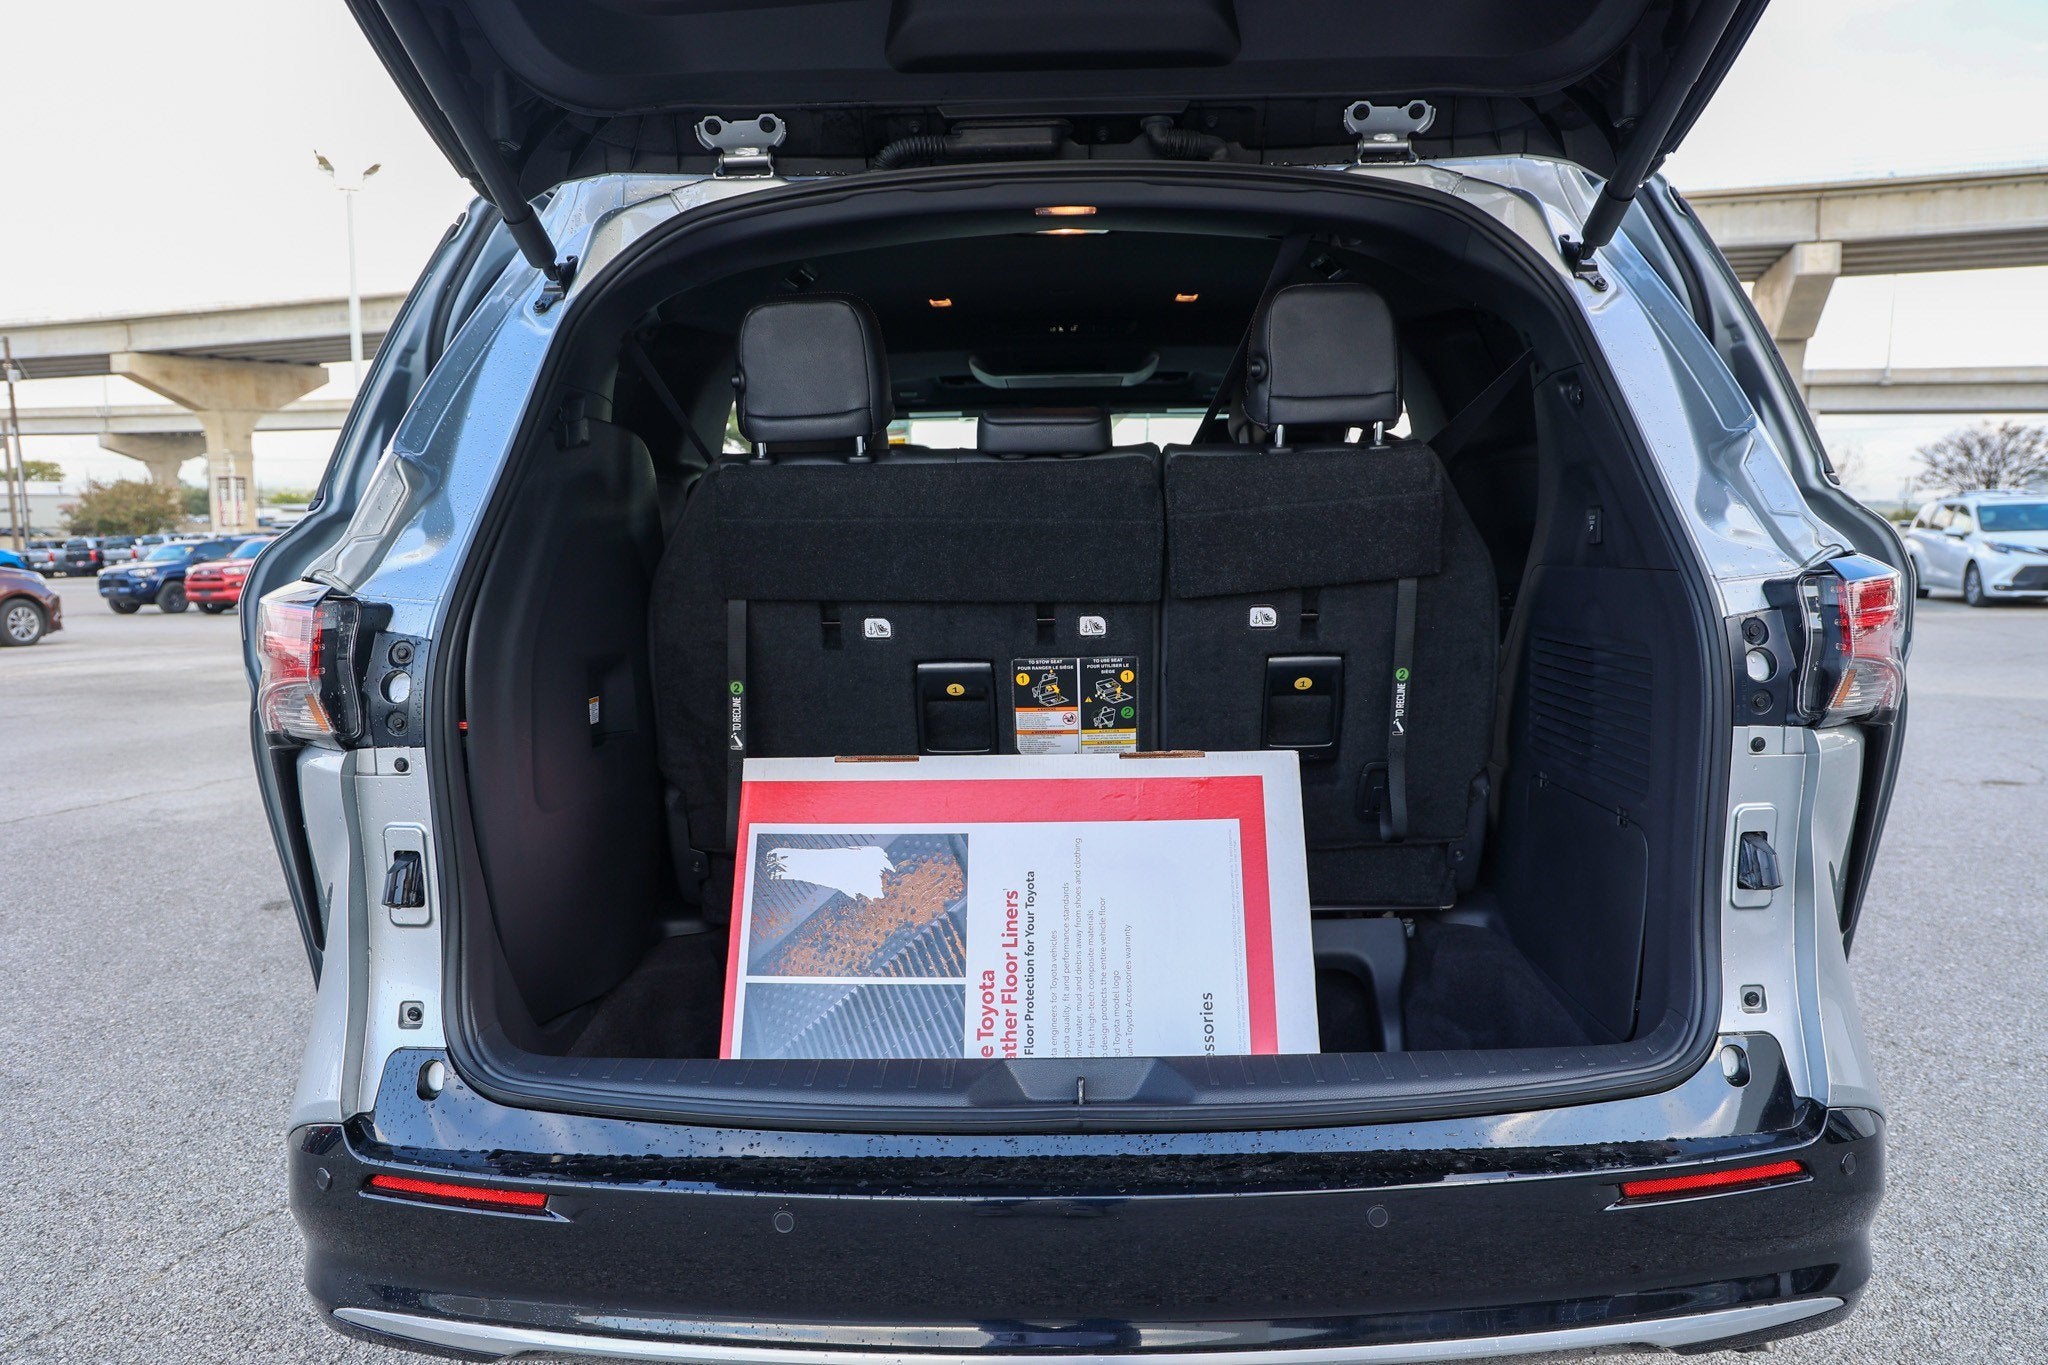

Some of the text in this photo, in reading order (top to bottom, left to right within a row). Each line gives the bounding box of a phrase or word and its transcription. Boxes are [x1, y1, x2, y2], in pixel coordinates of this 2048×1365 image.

[732, 697, 741, 732] TO RECLINE
[1395, 683, 1406, 717] TO RECLINE
[1073, 837, 1082, 868] clothing
[1062, 882, 1070, 921] standards
[1074, 886, 1082, 908] shoes
[1098, 897, 1106, 916] floor
[1074, 910, 1082, 928] from
[1086, 909, 1094, 945] materials
[1099, 917, 1107, 945] vehicle
[1050, 930, 1058, 962] vehicles
[1062, 923, 1072, 974] performance
[1123, 924, 1133, 959] warranty
[1024, 871, 1037, 1055] Floor Protection for Your Toyota
[1087, 947, 1096, 990] composite
[1099, 947, 1107, 970] entire
[1001, 952, 1018, 1004] Floor
[1050, 964, 1059, 990] Toyota
[1111, 970, 1121, 989] logo
[1125, 960, 1133, 1008] Accessories
[977, 970, 999, 1041] Toyota
[1062, 993, 1070, 1002] fit
[1087, 991, 1097, 1032] high-tech
[1100, 987, 1109, 1021] protects
[1112, 990, 1120, 1017] model
[1050, 1005, 1059, 1046] engineers
[1100, 1022, 1109, 1051] design
[1112, 1019, 1122, 1046] Toyota
[1125, 1009, 1135, 1037] Toyota
